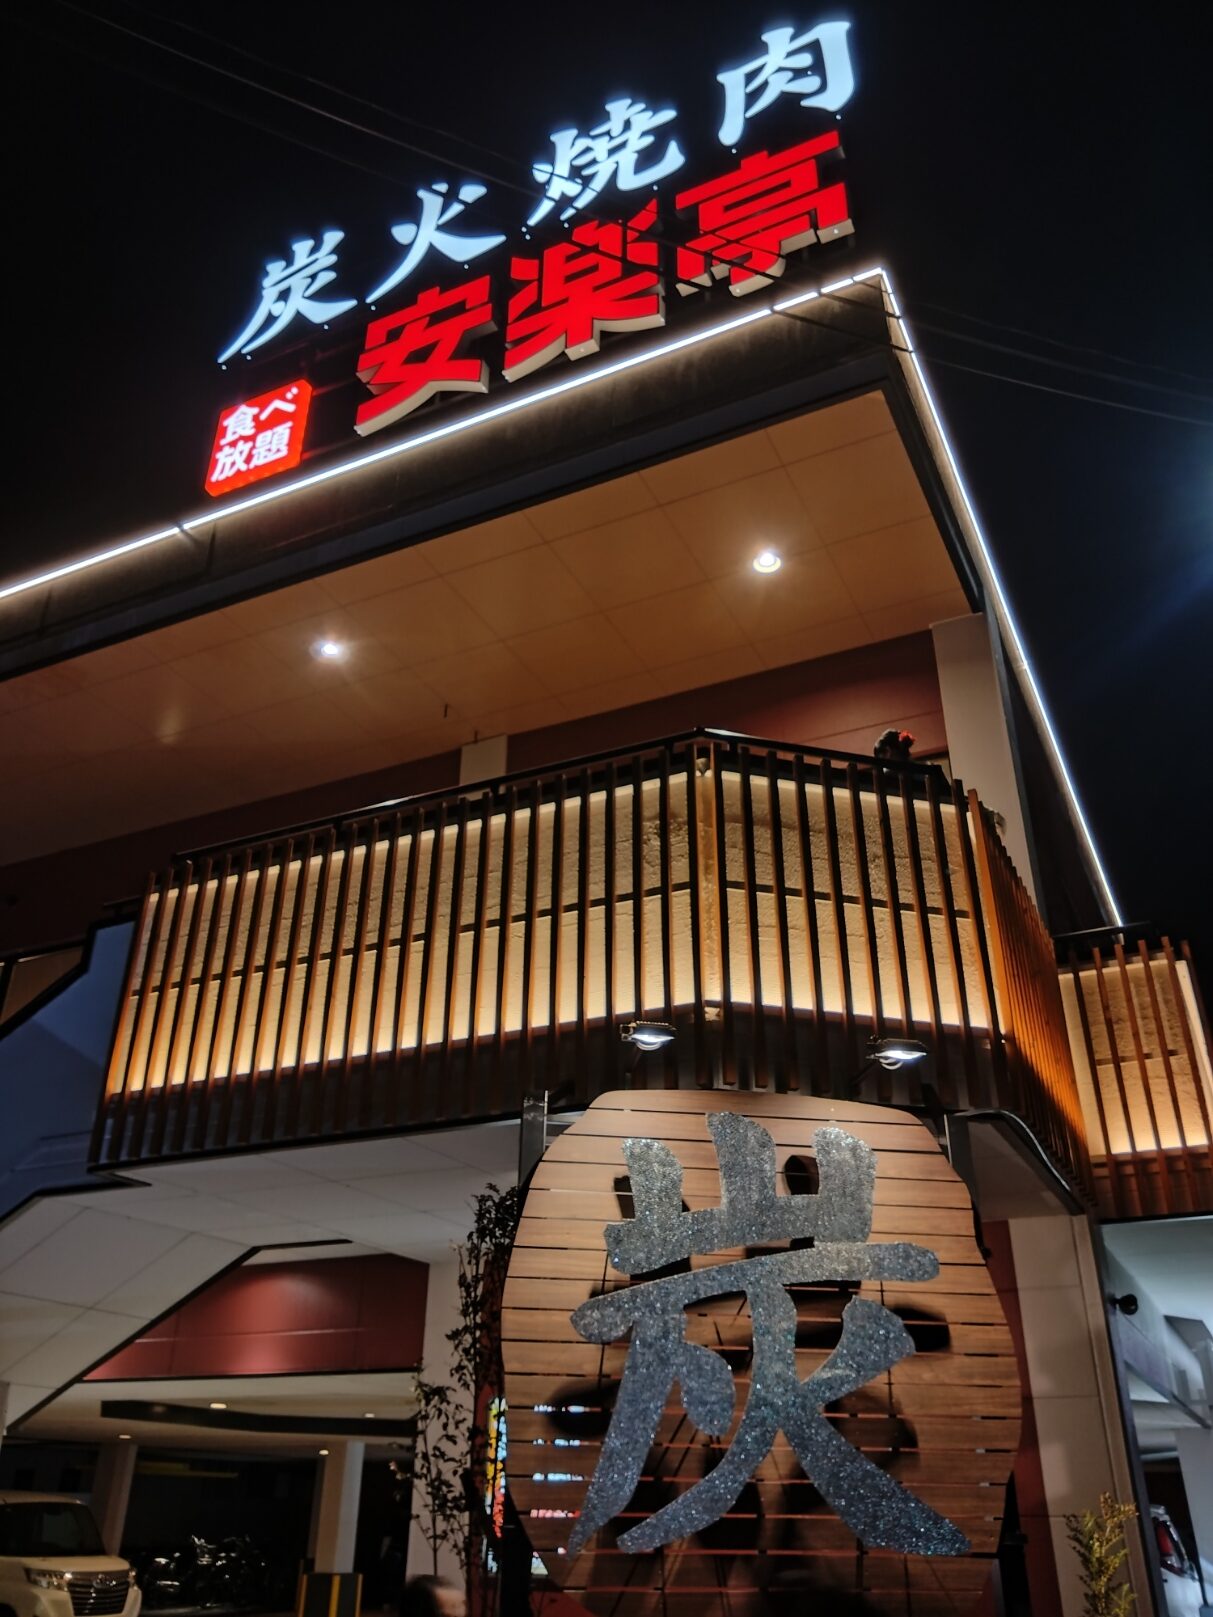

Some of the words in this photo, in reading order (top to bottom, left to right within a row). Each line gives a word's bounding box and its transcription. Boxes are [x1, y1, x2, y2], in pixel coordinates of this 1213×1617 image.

[217, 20, 854, 363] 炭火焼肉
[355, 131, 852, 435] 安楽亭
[211, 421, 293, 482] 放題
[220, 386, 298, 446] 食べ
[569, 1111, 972, 1556] 炭
